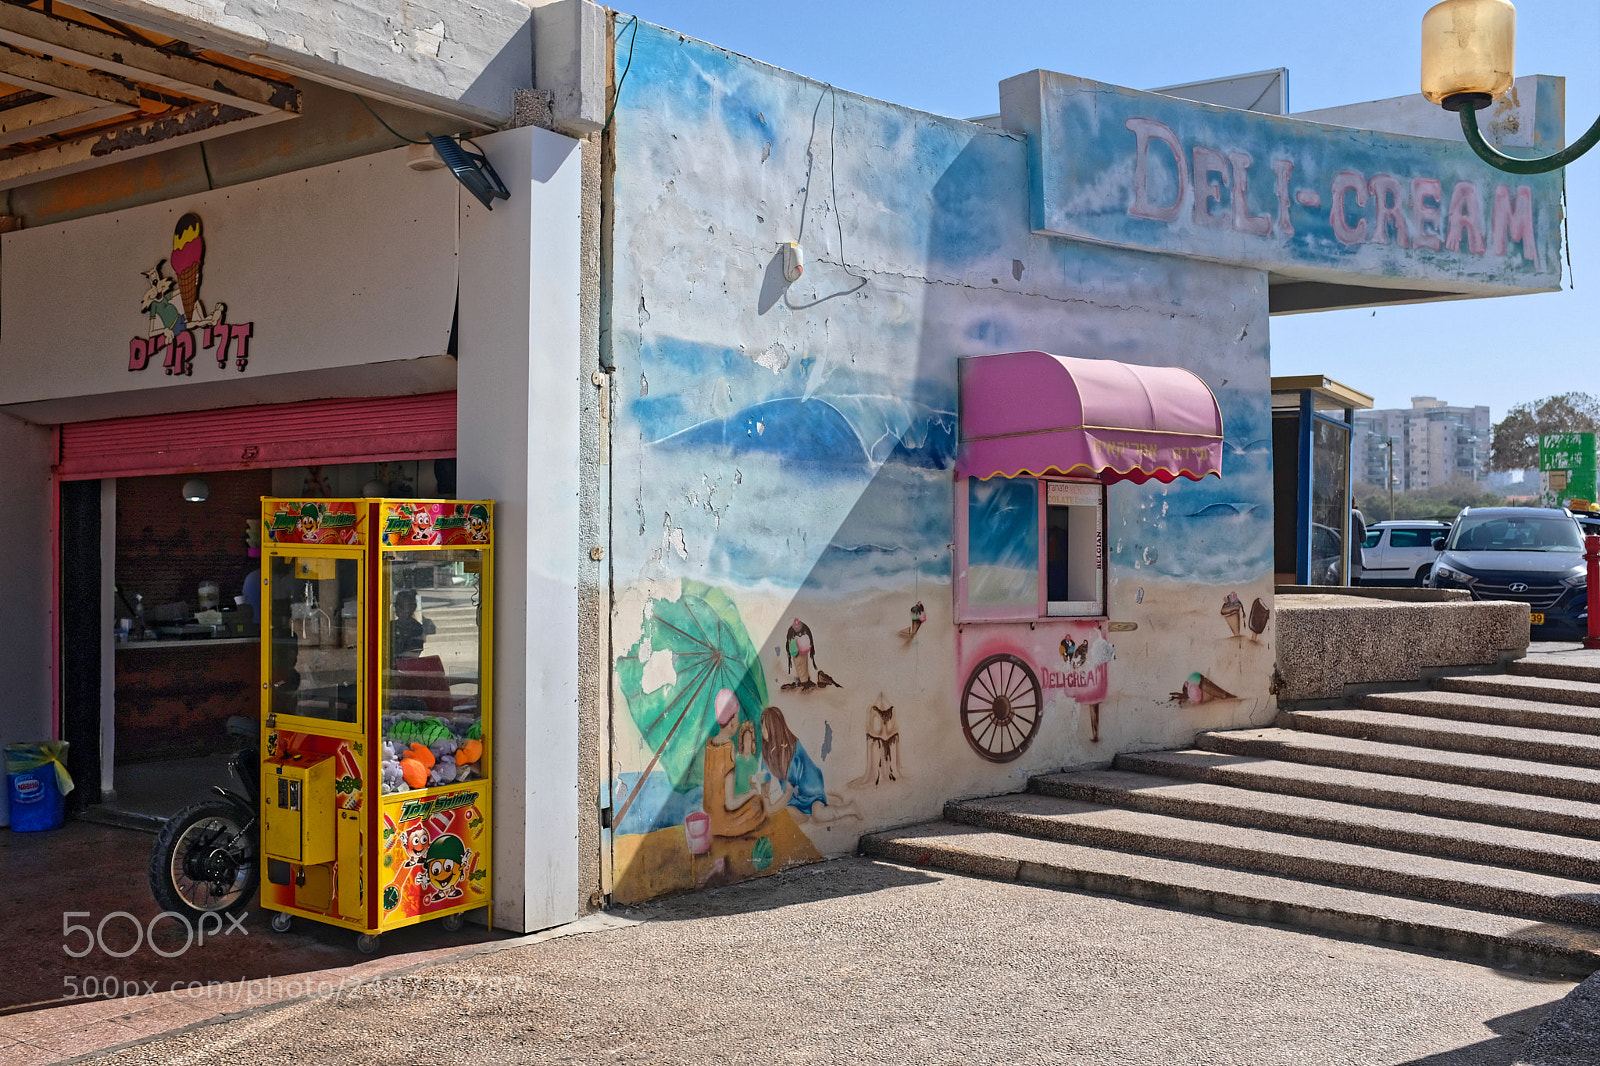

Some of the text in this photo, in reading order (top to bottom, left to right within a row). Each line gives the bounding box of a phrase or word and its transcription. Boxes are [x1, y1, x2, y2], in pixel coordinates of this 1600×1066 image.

[1125, 117, 1540, 268] DELI-CREAM
[384, 515, 414, 536] Toy
[1531, 614, 1543, 623] 39
[399, 791, 480, 823] Toy Soldier
